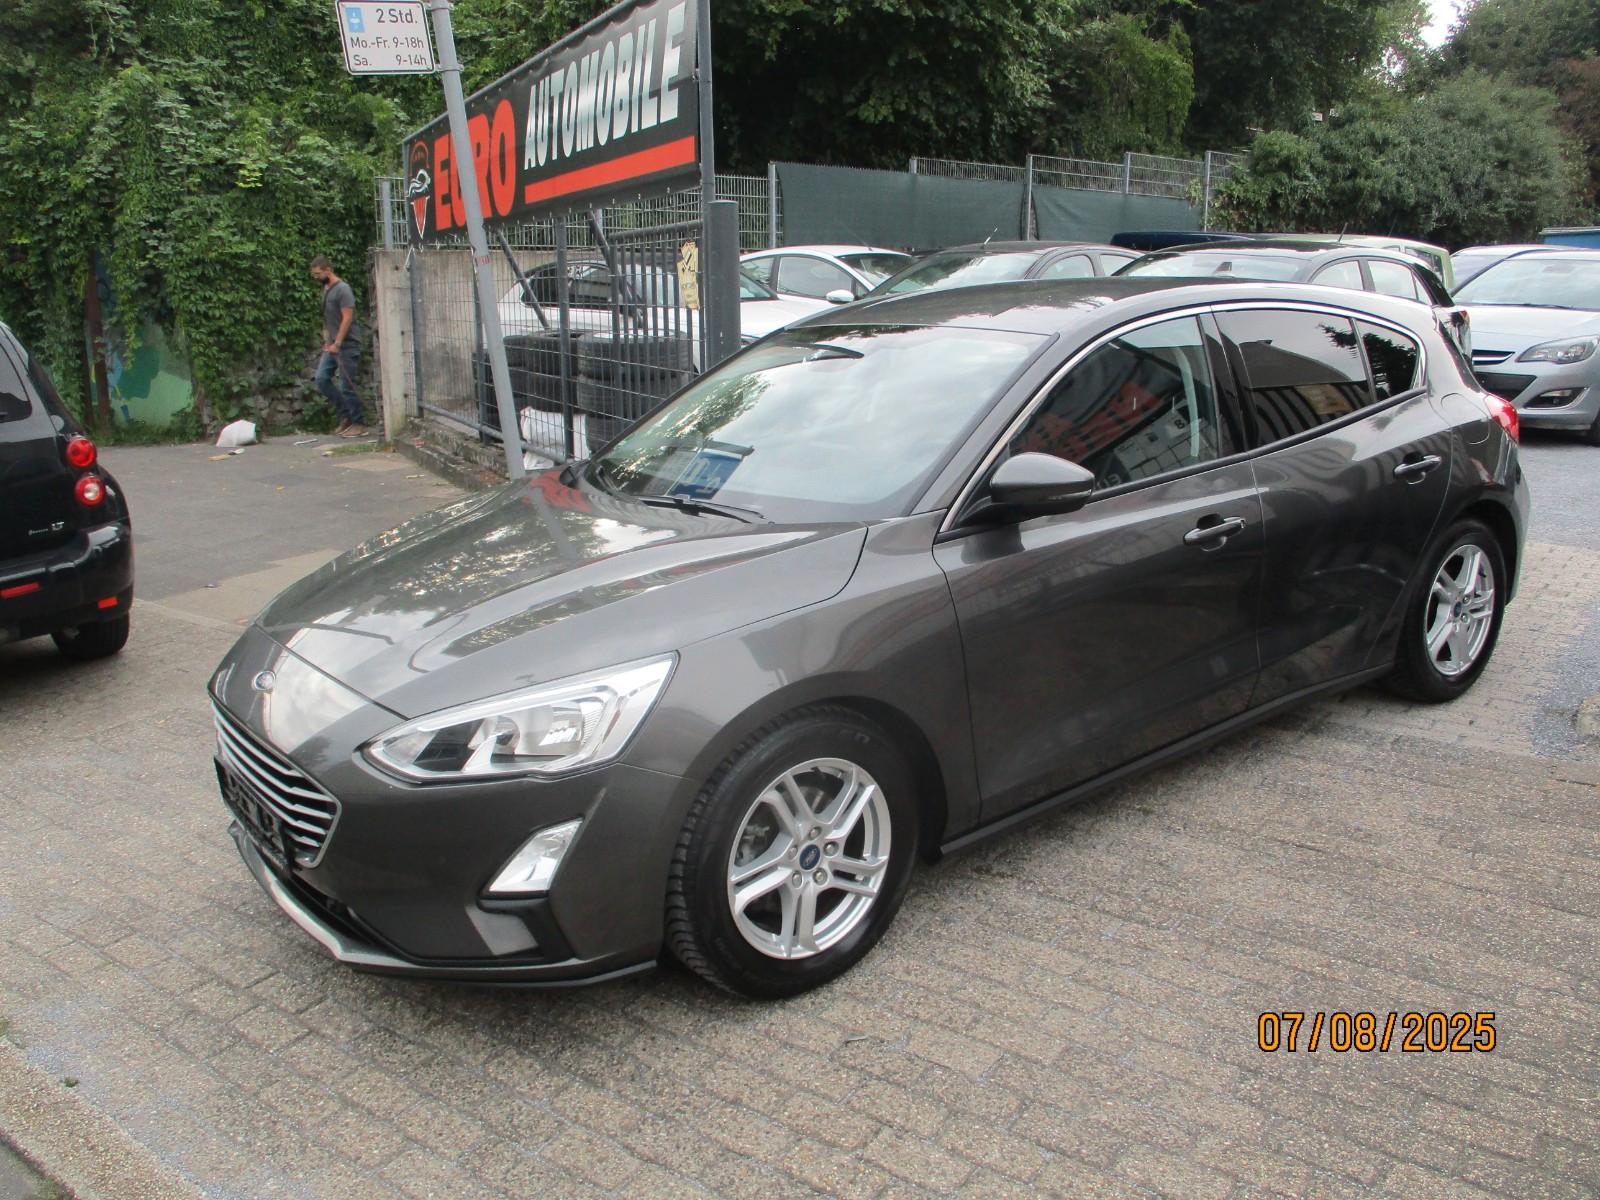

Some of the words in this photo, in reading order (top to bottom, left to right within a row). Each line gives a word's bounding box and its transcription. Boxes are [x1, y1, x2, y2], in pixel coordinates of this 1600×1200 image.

[375, 8, 386, 24] 2
[388, 8, 418, 24] Std.
[350, 36, 391, 49] Mo.-Fr.
[392, 36, 424, 49] 9-18h
[353, 54, 372, 66] Sa.
[395, 54, 427, 66] 9-14h
[524, 1, 686, 171] AUTOMOBILE
